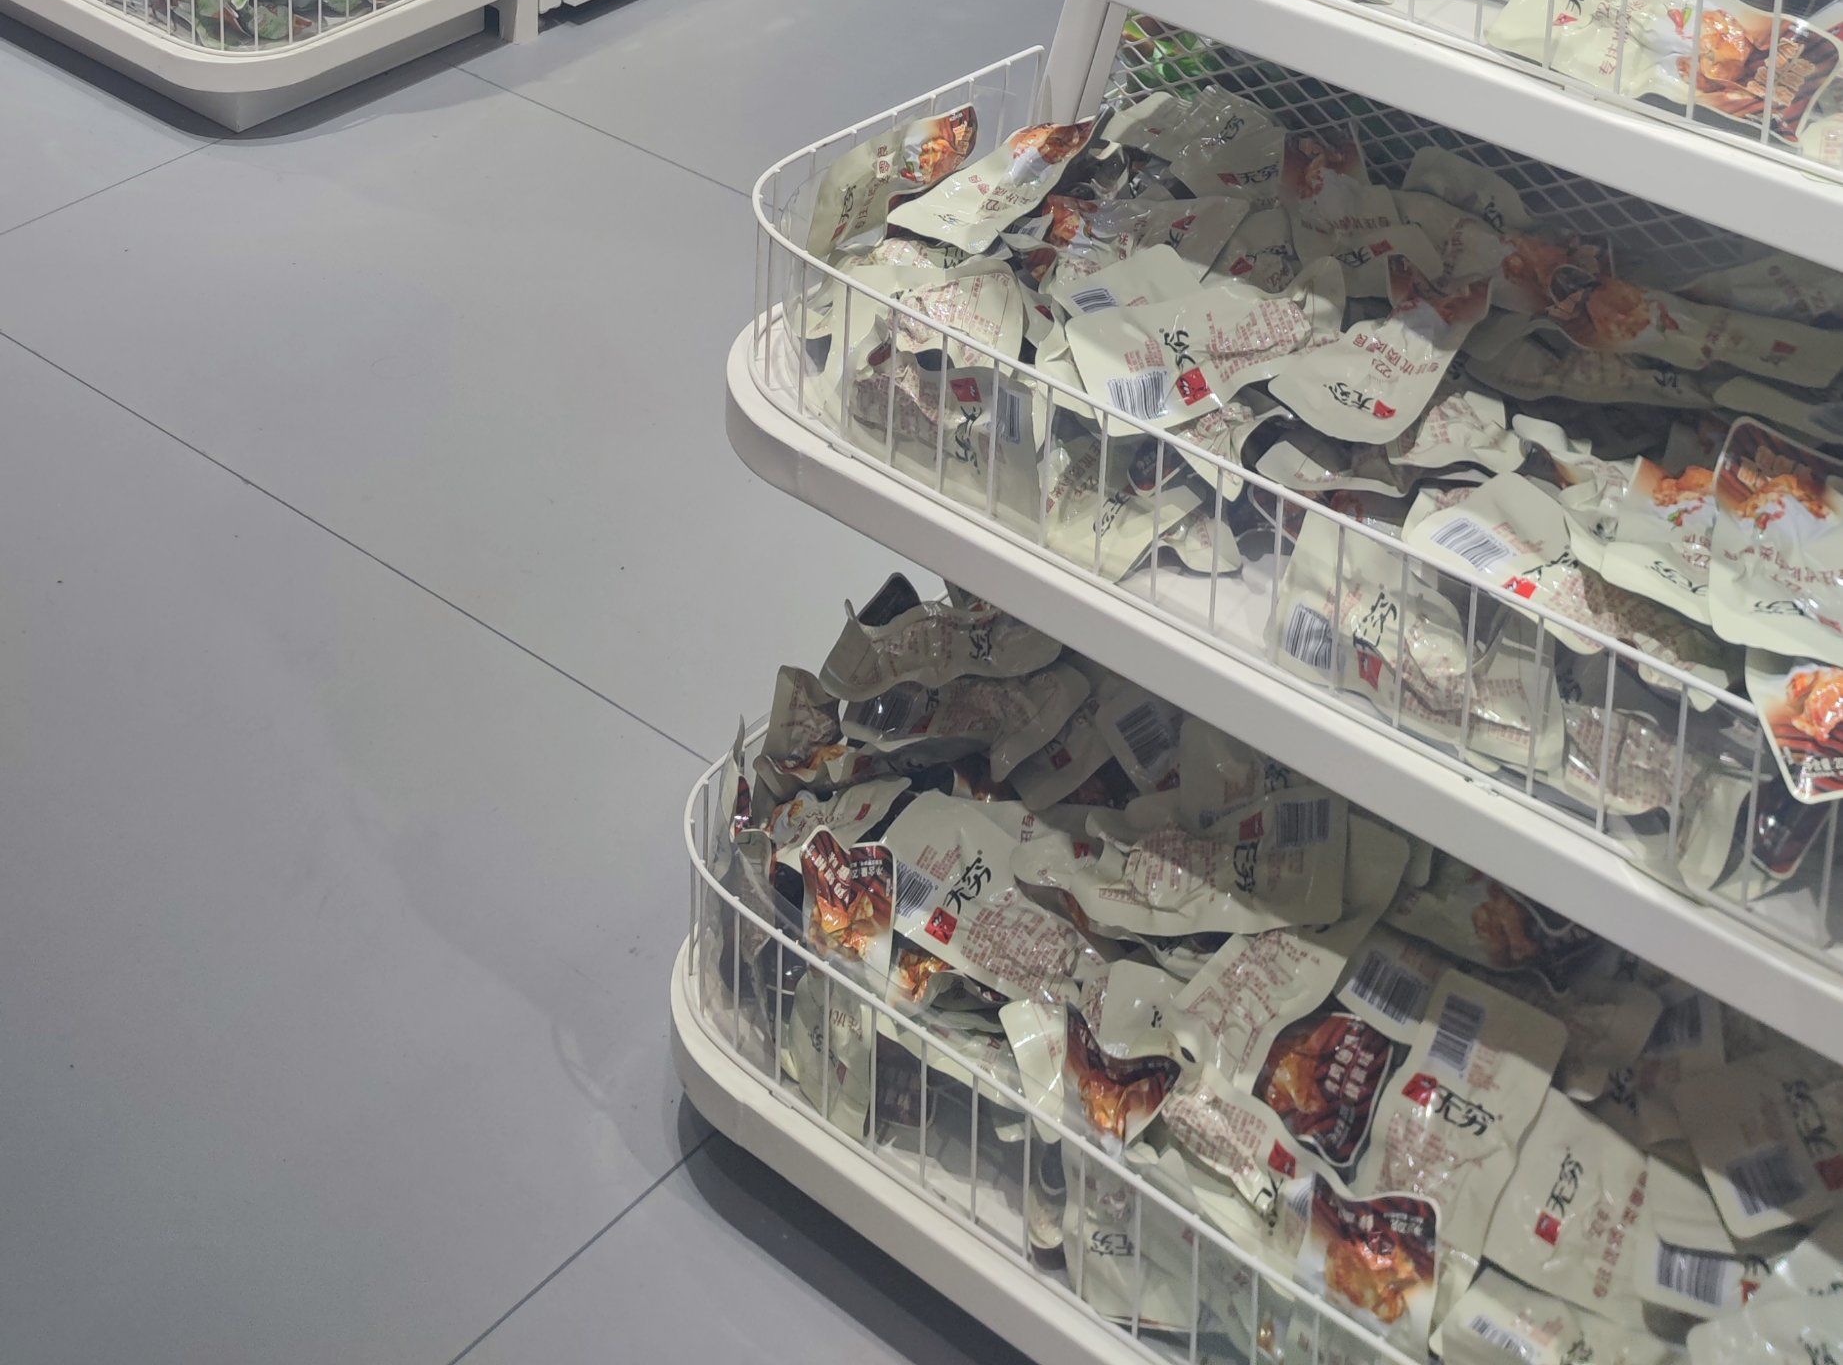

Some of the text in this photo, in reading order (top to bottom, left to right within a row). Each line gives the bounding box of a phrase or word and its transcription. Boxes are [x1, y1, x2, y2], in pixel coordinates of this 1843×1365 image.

[943, 854, 992, 913] 无穷
[1436, 1085, 1495, 1137] 无穷
[1547, 1153, 1584, 1217] 无穷
